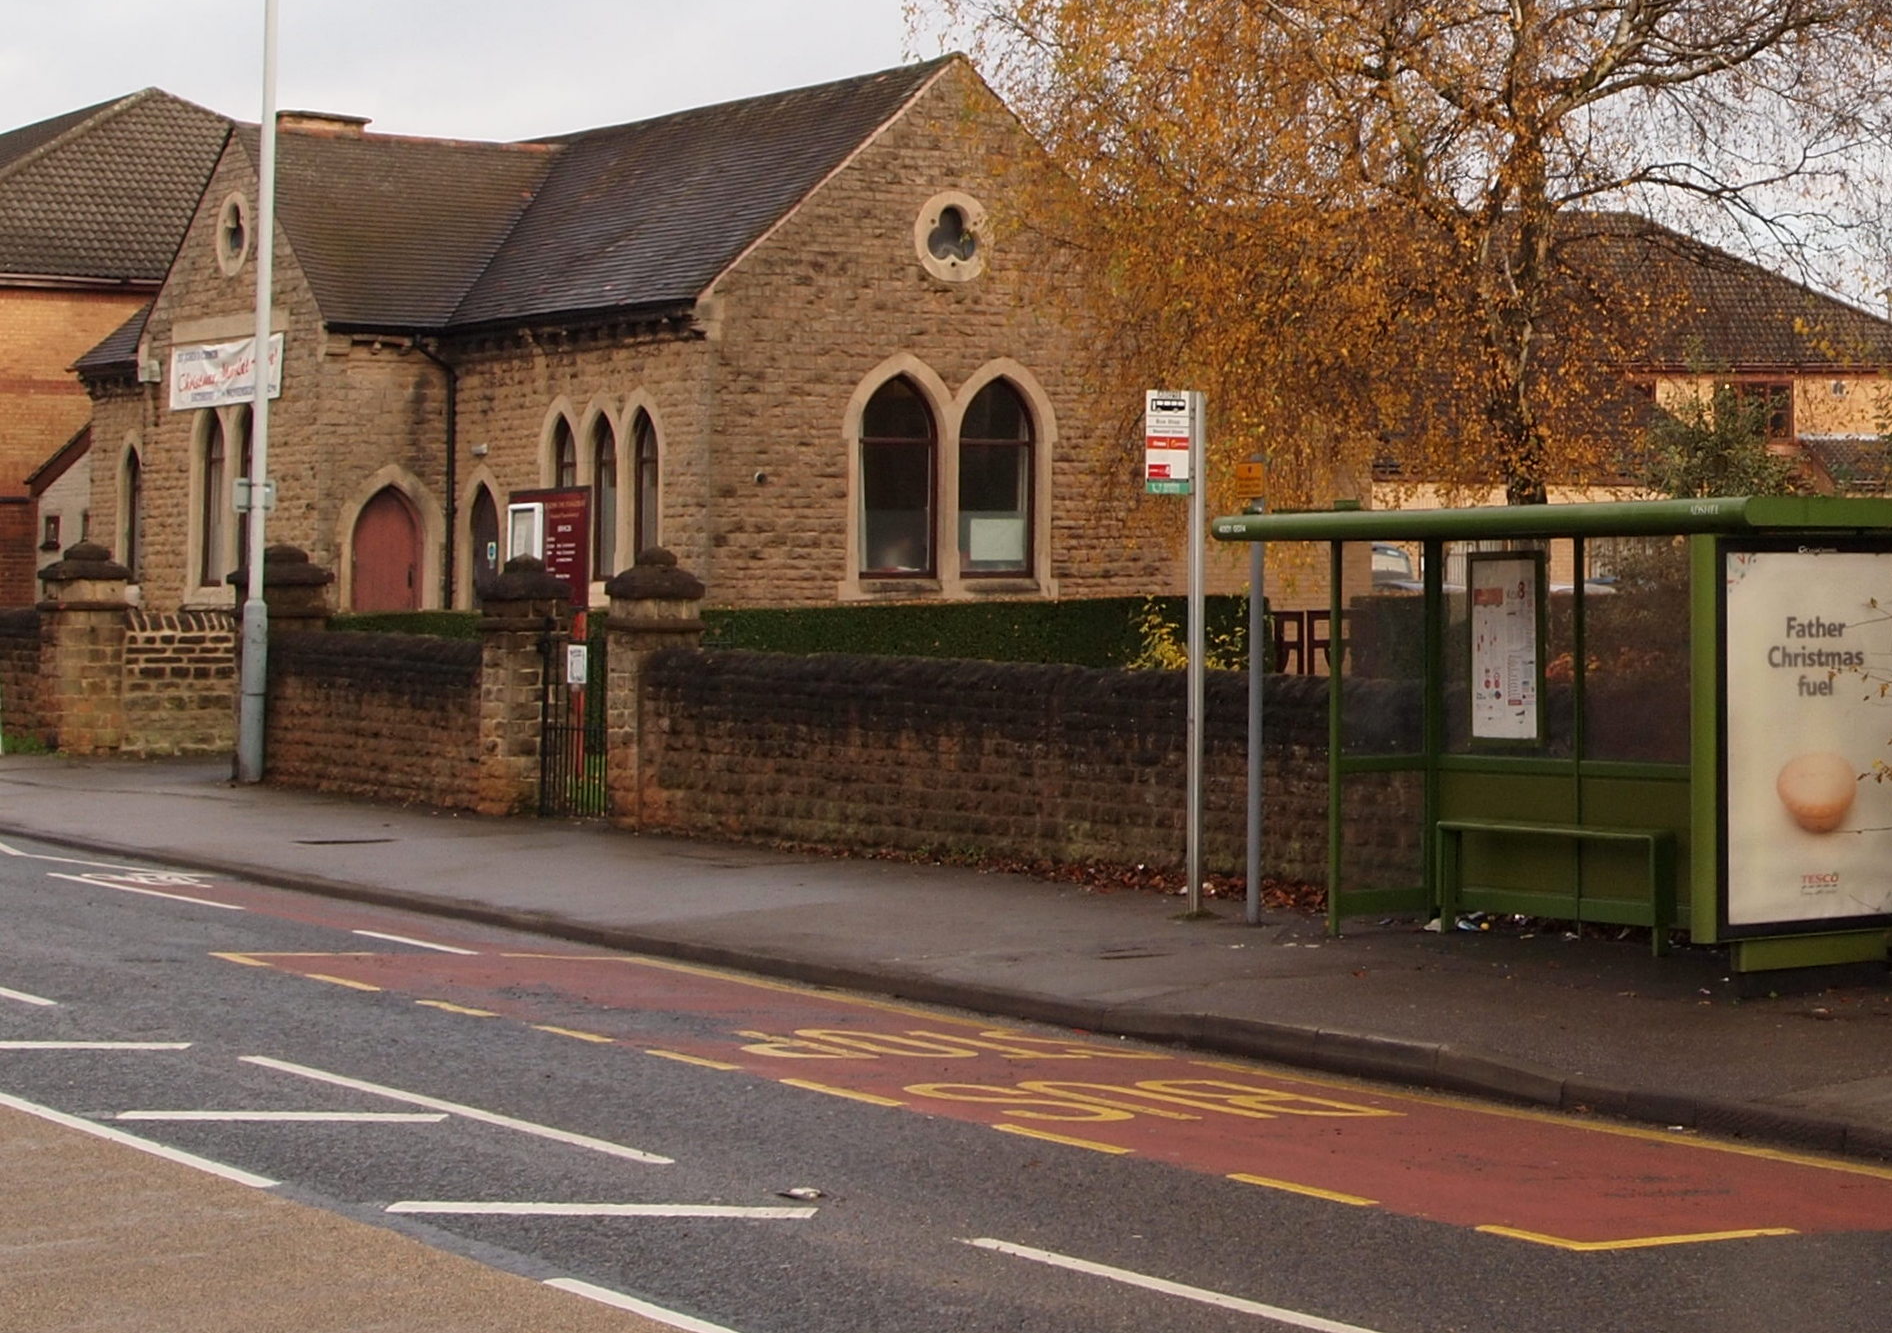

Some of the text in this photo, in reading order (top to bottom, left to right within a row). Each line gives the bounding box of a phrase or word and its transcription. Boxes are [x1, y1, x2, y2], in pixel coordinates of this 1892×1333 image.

[1785, 616, 1847, 639] Father
[1767, 646, 1864, 669] Christmas
[1797, 675, 1834, 697] fuel
[1801, 873, 1840, 884] TESCO
[731, 1028, 1176, 1059] STOP
[900, 1079, 1407, 1121] BUS
